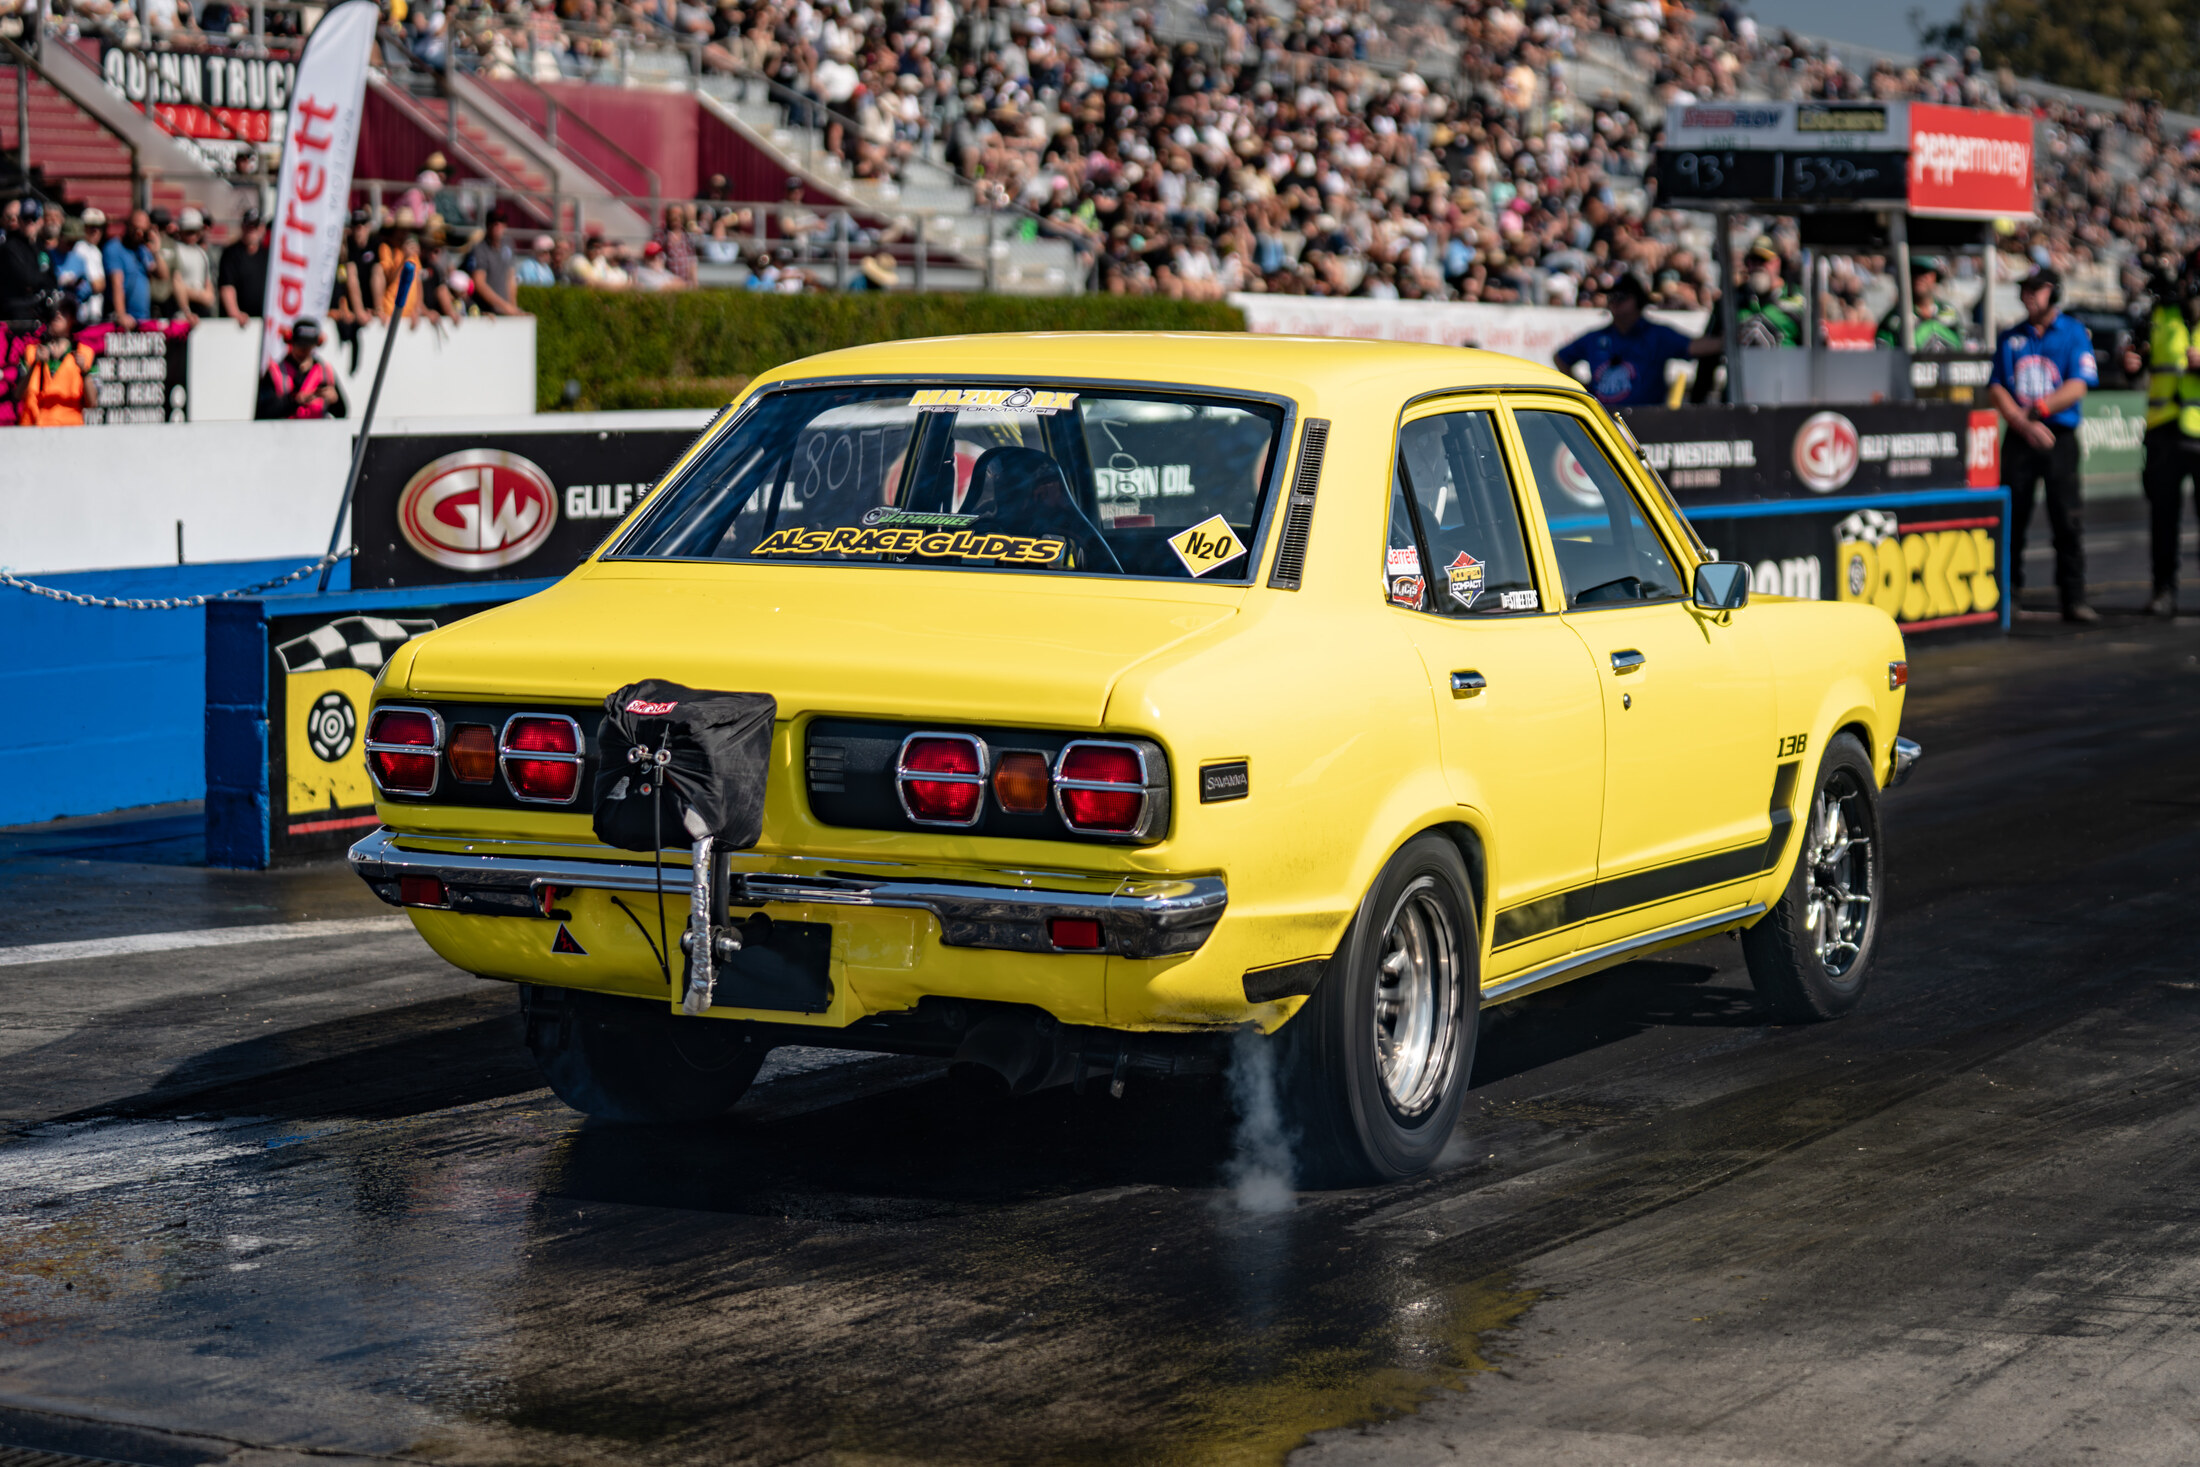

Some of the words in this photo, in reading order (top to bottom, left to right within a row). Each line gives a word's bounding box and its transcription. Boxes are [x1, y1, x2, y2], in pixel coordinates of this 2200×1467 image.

[1914, 130, 2030, 188] peppermoney
[1096, 467, 1158, 498] STERN
[1161, 465, 1195, 495] OIL
[566, 484, 632, 519] GULF
[824, 528, 924, 554] RACE
[915, 531, 1066, 563] GLIDES
[1184, 531, 1233, 560] N2O
[1452, 579, 1482, 591] COMPACT
[1777, 733, 1808, 758] 13B
[1207, 774, 1248, 791] SAVANNA
